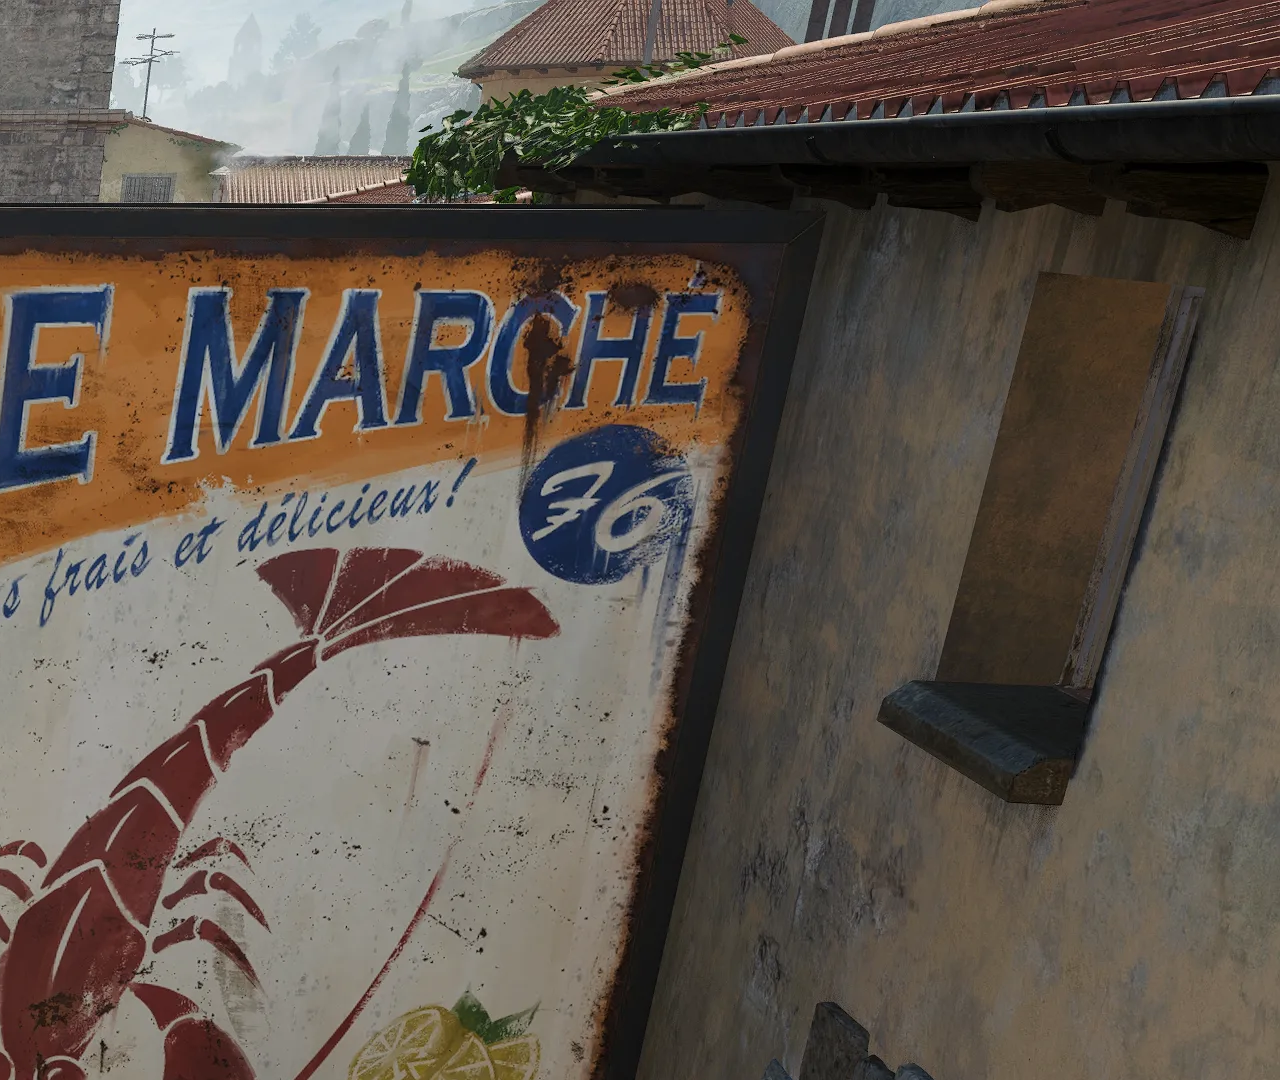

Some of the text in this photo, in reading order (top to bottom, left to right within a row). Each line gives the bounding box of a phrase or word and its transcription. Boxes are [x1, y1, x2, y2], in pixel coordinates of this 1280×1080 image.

[161, 259, 724, 467] MARCHÉ
[40, 532, 152, 628] frais
[174, 516, 227, 568] et
[237, 456, 479, 552] délicieux!
